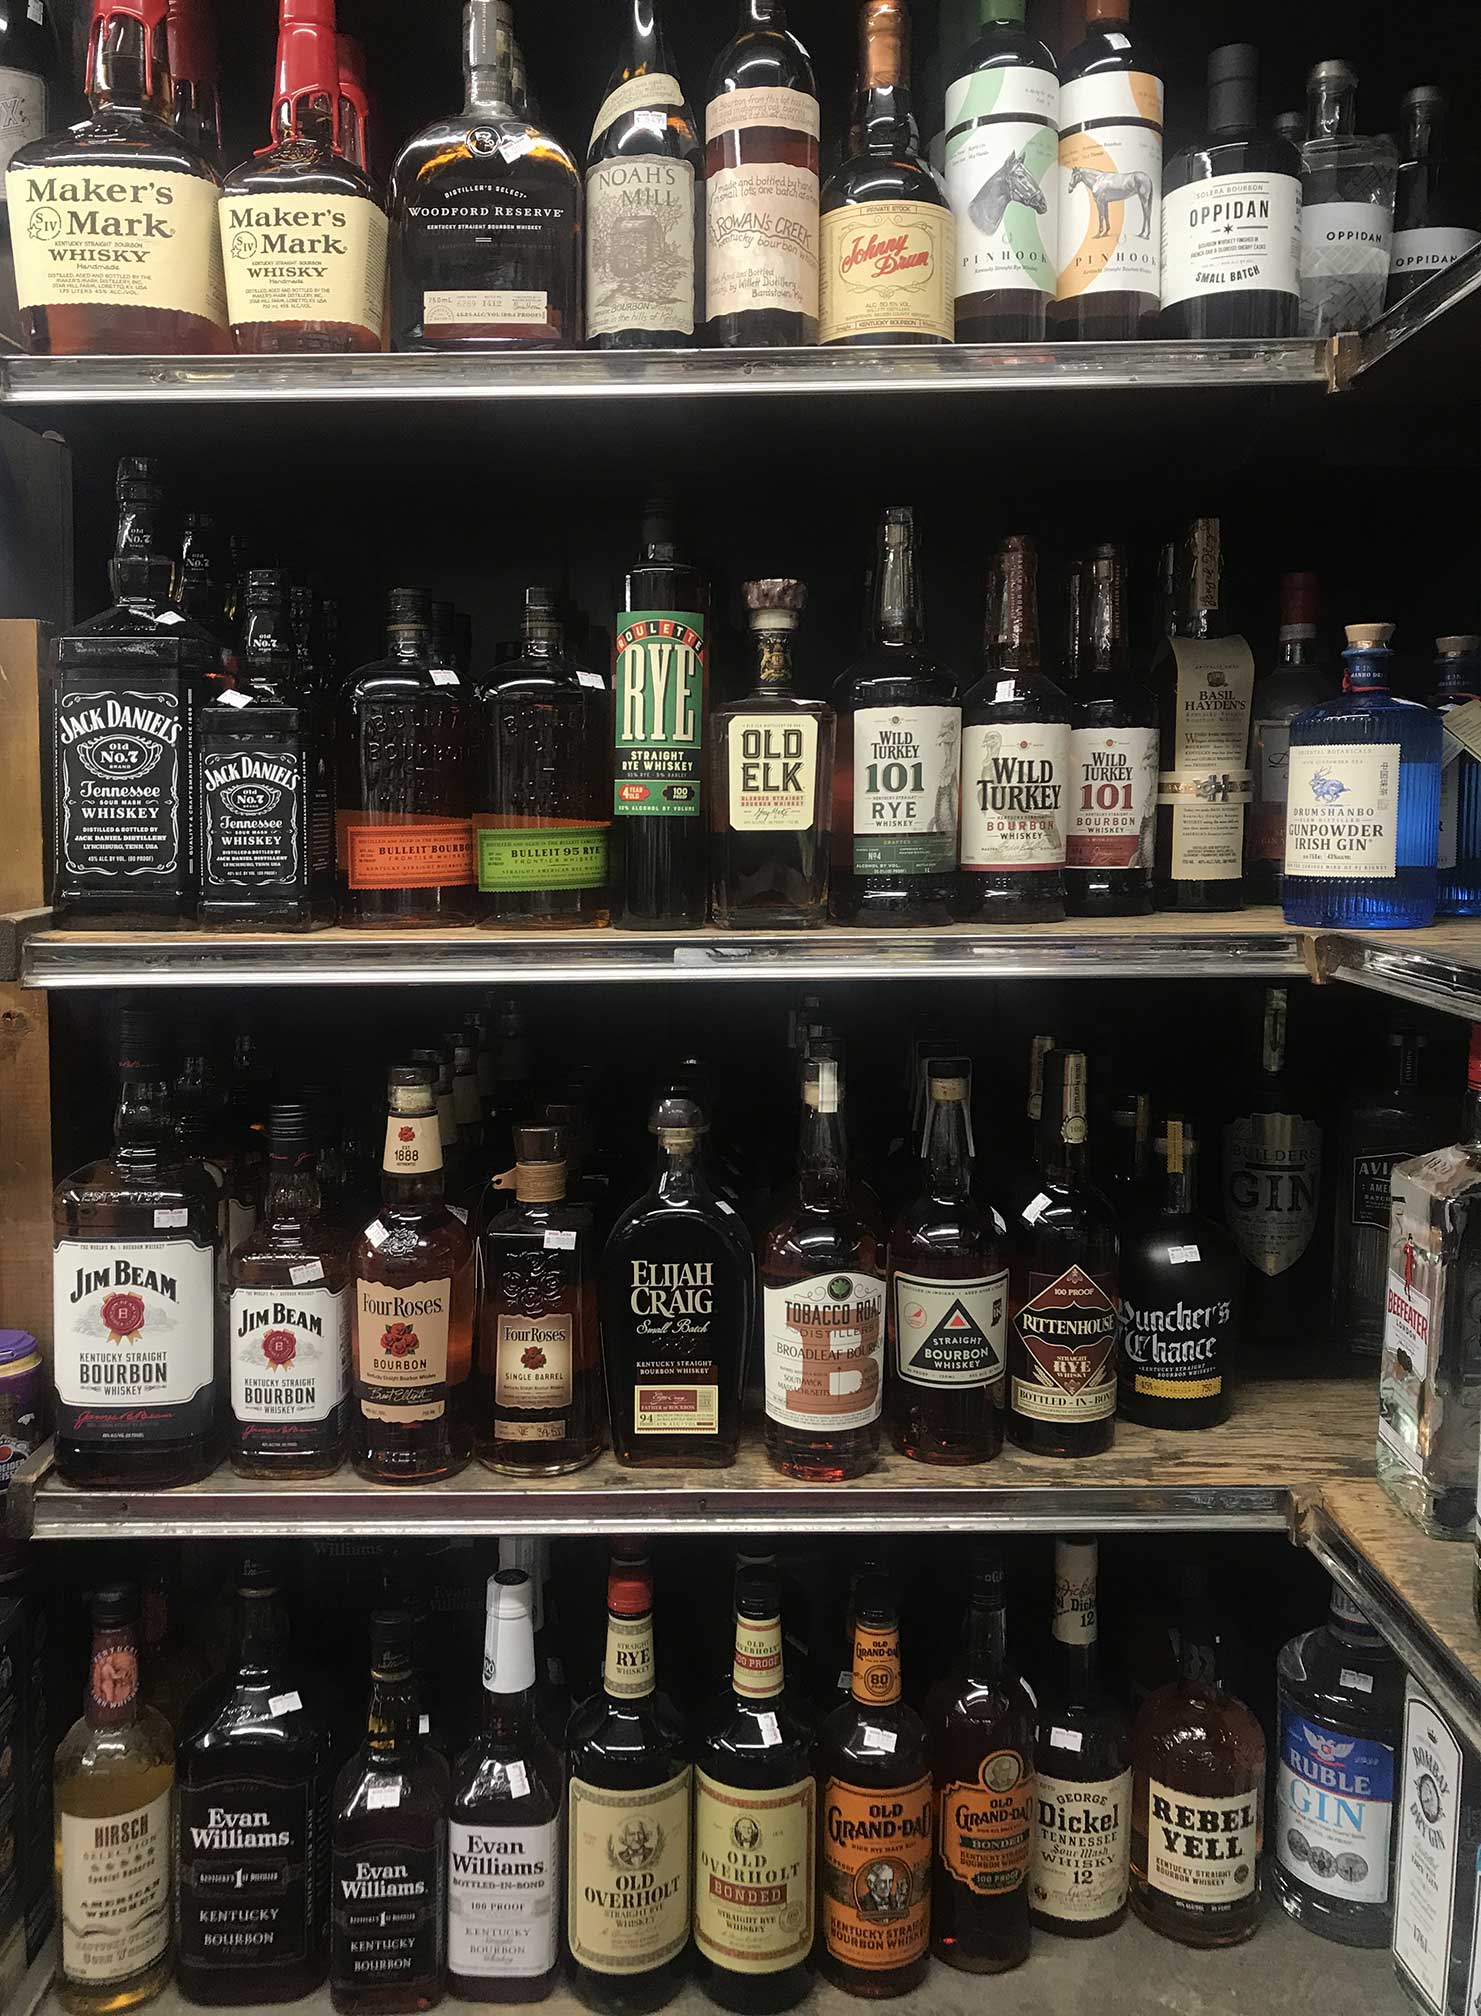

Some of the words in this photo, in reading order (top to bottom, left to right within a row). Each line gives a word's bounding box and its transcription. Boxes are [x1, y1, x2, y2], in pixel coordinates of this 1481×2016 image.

[599, 166, 675, 190] NOAH'S
[26, 178, 174, 205] Maker's
[444, 185, 493, 198] DISTILLER'S
[495, 186, 525, 198] SELECT
[622, 188, 675, 207] MILL
[229, 207, 347, 228] Maker's
[408, 207, 489, 217] WOODFORD
[495, 206, 563, 218] RESERVE
[1189, 200, 1270, 228] OPPIDAN
[66, 210, 174, 239] Mark
[775, 216, 812, 249] CREEK
[260, 234, 346, 254] Mark
[1326, 231, 1382, 243] OPPIDAN
[841, 233, 909, 273] Johnny
[962, 250, 1048, 268] PINHOOK
[1075, 251, 1157, 268] PINHOOK
[1395, 254, 1458, 267] OPPIDAN
[247, 268, 328, 277] WHISKY
[871, 250, 930, 278] Drum
[1195, 271, 1226, 284] SMALL
[1229, 264, 1261, 282] BATCH
[858, 320, 889, 328] KENTUCKY
[889, 319, 918, 327] BOURBON
[617, 622, 704, 652] ROULETTE
[622, 643, 696, 743] RYE
[1200, 690, 1236, 701] BASIL
[1184, 700, 1246, 711] HAYDEN'S
[59, 707, 106, 745] JACK
[106, 699, 184, 745] DANIEL'S
[109, 742, 130, 751] Old
[741, 729, 803, 759] OLD
[879, 731, 913, 746] WILD
[630, 750, 685, 761] STRAIGHT
[871, 742, 920, 760] TURKEY
[1092, 752, 1127, 767] WILD
[204, 762, 241, 791] JACK
[241, 756, 301, 791] DANIEL'S
[622, 761, 639, 772] RYE
[643, 761, 694, 772] WHISKEY
[991, 757, 1054, 784] WILD
[1081, 764, 1134, 783] TURKEY
[741, 762, 805, 792] ELK
[865, 762, 925, 793] 101
[79, 780, 161, 798] Tennessee
[622, 784, 629, 799] 4
[672, 787, 689, 796] 100
[976, 780, 1062, 813] TURKEY
[1080, 783, 1134, 811] 101
[81, 807, 160, 819] WHISKEY
[871, 801, 917, 819] RYE
[1293, 808, 1375, 817] DRUMSHANBO
[220, 815, 283, 829] Tennessee
[875, 819, 914, 827] WHISKEY
[1288, 824, 1384, 838] GUNPOWDER
[221, 836, 282, 845] WHISKEY
[1000, 832, 1043, 840] WHISKEY
[1295, 838, 1330, 851] IRISH
[1336, 838, 1368, 851] GIN
[379, 846, 427, 855] BULLEIT
[511, 848, 561, 858] BULLEIT
[563, 847, 580, 856] 95
[582, 846, 601, 855] RYE
[394, 1149, 420, 1163] 1888
[1231, 1170, 1316, 1213] GIN
[70, 1267, 110, 1304] JIM
[115, 1260, 178, 1304] BEAM
[630, 1260, 714, 1291] ELIJAH
[1054, 1288, 1067, 1296] 100
[1068, 1287, 1095, 1296] PROOF
[362, 1292, 392, 1317] Four
[393, 1297, 443, 1318] Roses
[630, 1287, 713, 1318] CRAIG
[238, 1309, 269, 1338] JIM
[273, 1302, 323, 1337] BEAM
[785, 1300, 850, 1326] TOBACCO
[1387, 1287, 1428, 1345] BEEFEATER
[800, 1326, 874, 1339] DISTILLERS
[1022, 1312, 1115, 1335] RITTENHOUSE
[503, 1326, 531, 1342] Four
[531, 1328, 566, 1342] Roses
[933, 1337, 982, 1346] STRAIGHT
[924, 1347, 989, 1361] BOURBON
[1124, 1330, 1217, 1364] Chance
[80, 1363, 167, 1384] BOURBON
[373, 1359, 427, 1370] BOURBON
[934, 1360, 981, 1369] WHISKEY
[1052, 1361, 1092, 1373] RYE
[244, 1378, 280, 1387] KENTUCKY
[281, 1378, 315, 1387] STRAIGHT
[535, 1373, 563, 1381] BARREL
[104, 1385, 142, 1396] WHISKEY
[244, 1387, 316, 1405] BOURBON
[264, 1406, 295, 1414] WHISKEY
[640, 1414, 654, 1423] 94
[747, 1640, 765, 1648] OLD
[616, 1650, 650, 1667] RYE
[1290, 1747, 1372, 1796] RUBLE
[1411, 1747, 1450, 1796] BOMBAY
[990, 1797, 1013, 1809] OLD
[1056, 1793, 1108, 1806] GEORGE
[1290, 1779, 1366, 1833] GIN
[208, 1808, 270, 1829] Evan
[869, 1803, 904, 1818] OLD
[1038, 1800, 1119, 1834] Dickel
[1152, 1793, 1255, 1833] REBEL
[95, 1813, 149, 1848] HIRSCH
[1409, 1801, 1428, 1838] DRY
[1428, 1828, 1446, 1850] GIN
[190, 1827, 291, 1850] Williams
[467, 1835, 526, 1855] Evan
[1041, 1828, 1118, 1847] TENNESSEE
[1161, 1826, 1243, 1860] YELL
[452, 1852, 544, 1876] Williams
[701, 1851, 800, 1884] OVERHOLT
[727, 1851, 768, 1868] OLD
[355, 1863, 409, 1881] Evan
[341, 1880, 426, 1900] Williams
[615, 1872, 655, 1891] OLD
[585, 1874, 681, 1909] OVERHOLT
[714, 1878, 781, 1904] BONDED
[471, 1902, 487, 1911] 100
[490, 1902, 525, 1911] PROOF
[465, 1928, 530, 1937] KENTUCKY
[1413, 1923, 1428, 1955] 1761
